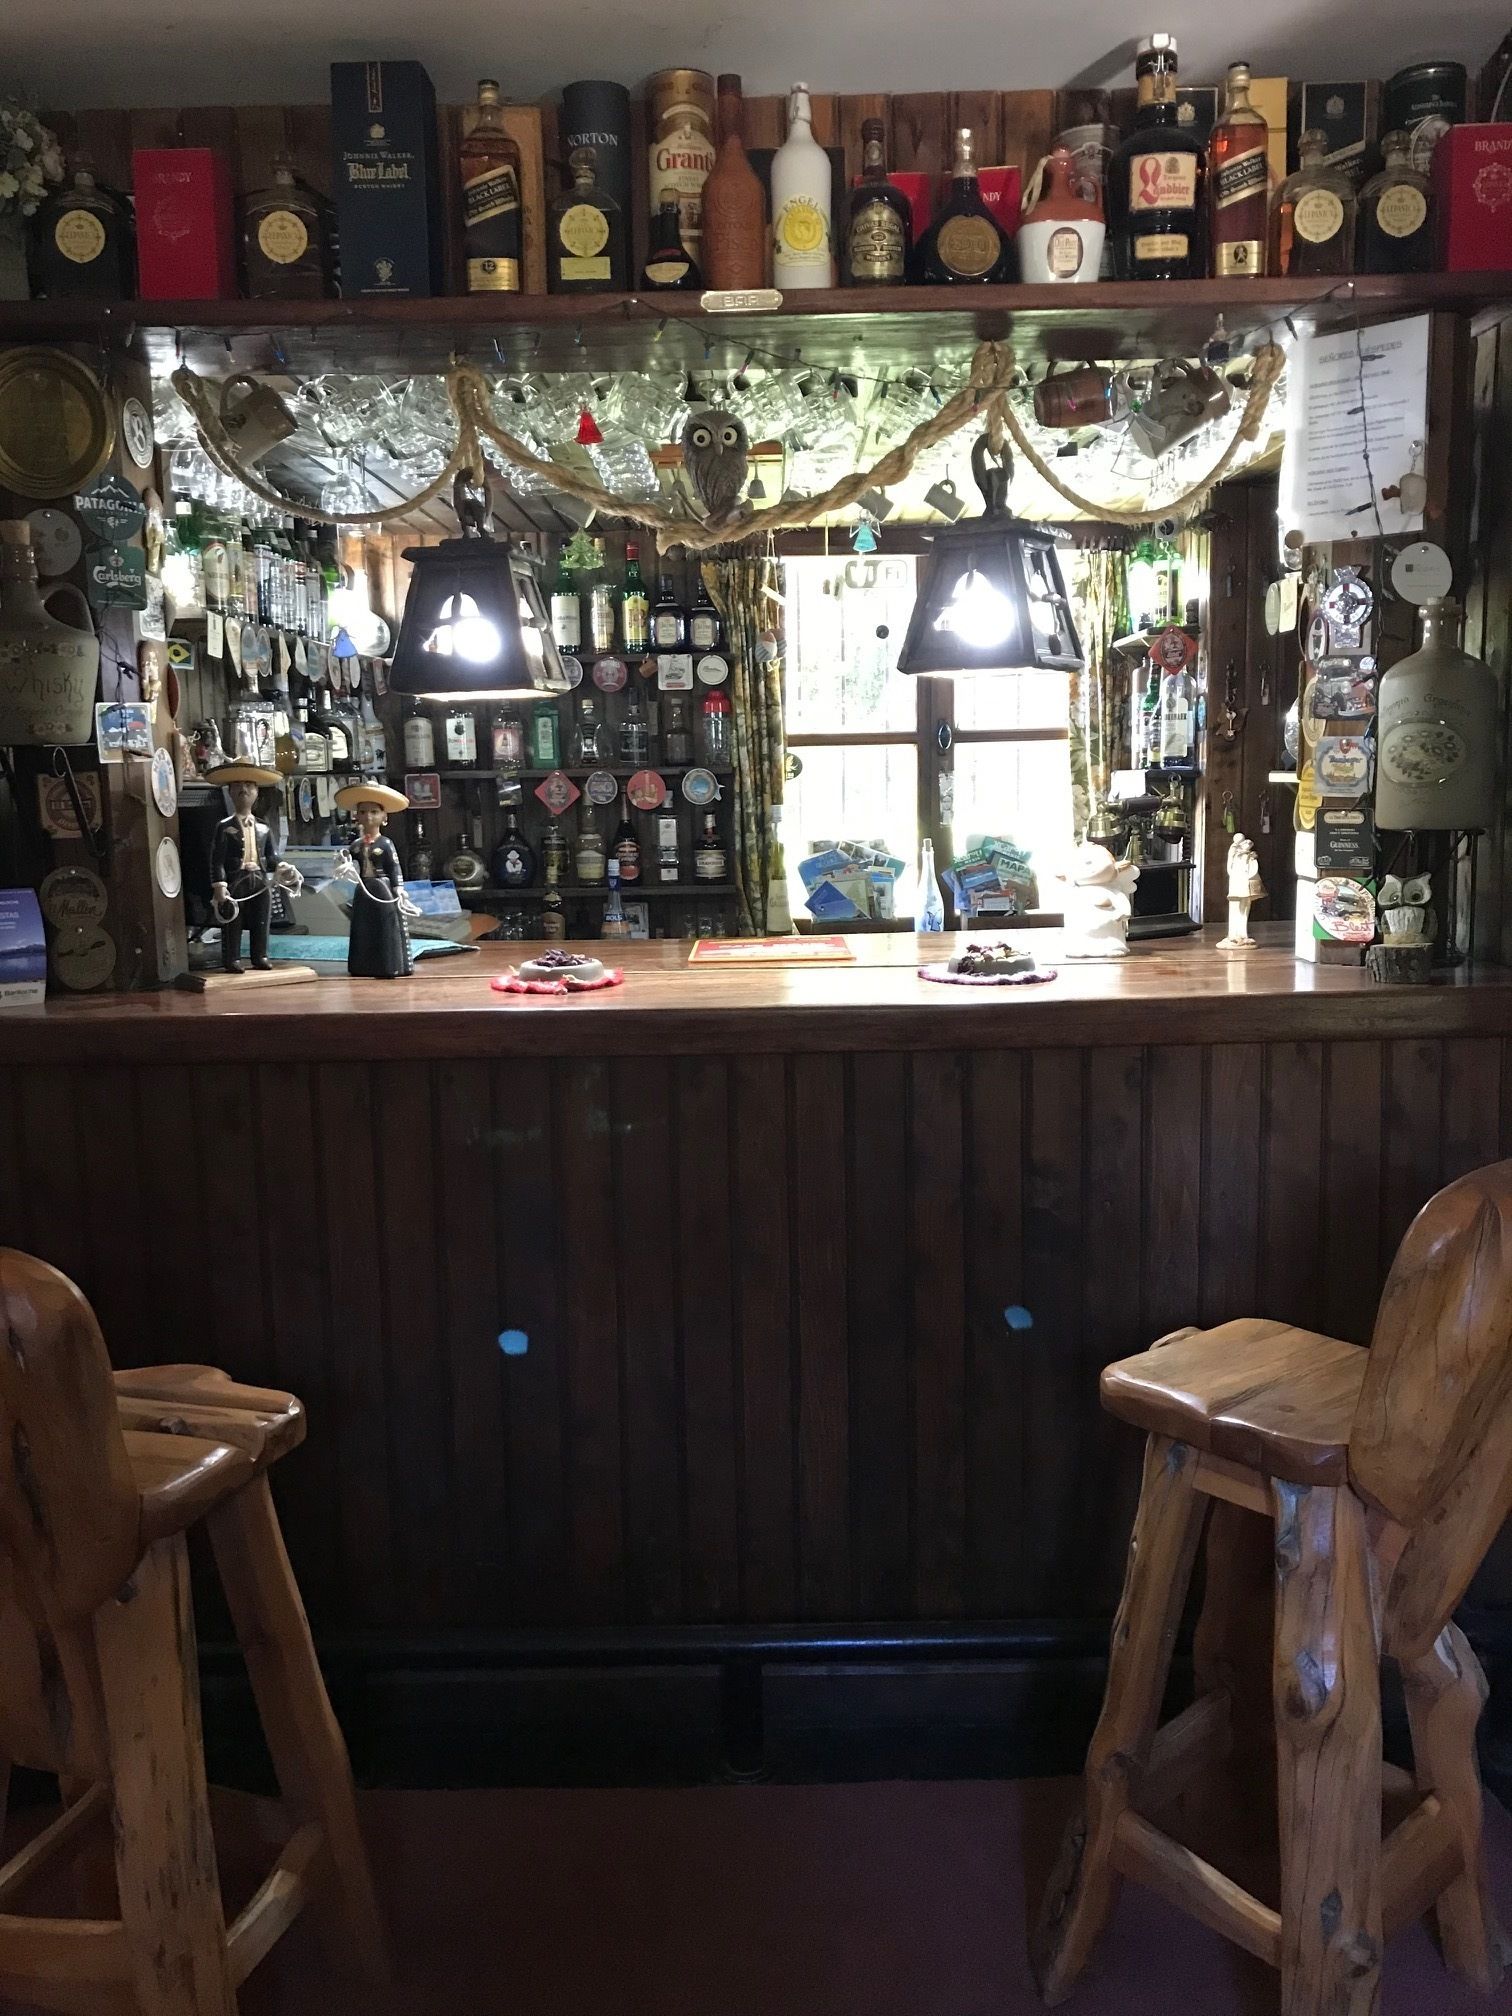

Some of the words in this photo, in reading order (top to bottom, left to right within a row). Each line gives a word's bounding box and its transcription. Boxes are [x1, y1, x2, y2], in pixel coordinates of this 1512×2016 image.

[346, 162, 377, 181] Blue
[377, 162, 411, 180] Label
[1244, 162, 1264, 178] LABEL
[489, 181, 511, 195] LABEL
[484, 261, 495, 272] 12
[723, 296, 759, 307] BAR
[93, 565, 142, 586] Carlsberg
[1330, 840, 1359, 849] GUINNESS
[1330, 920, 1375, 932] Blest
